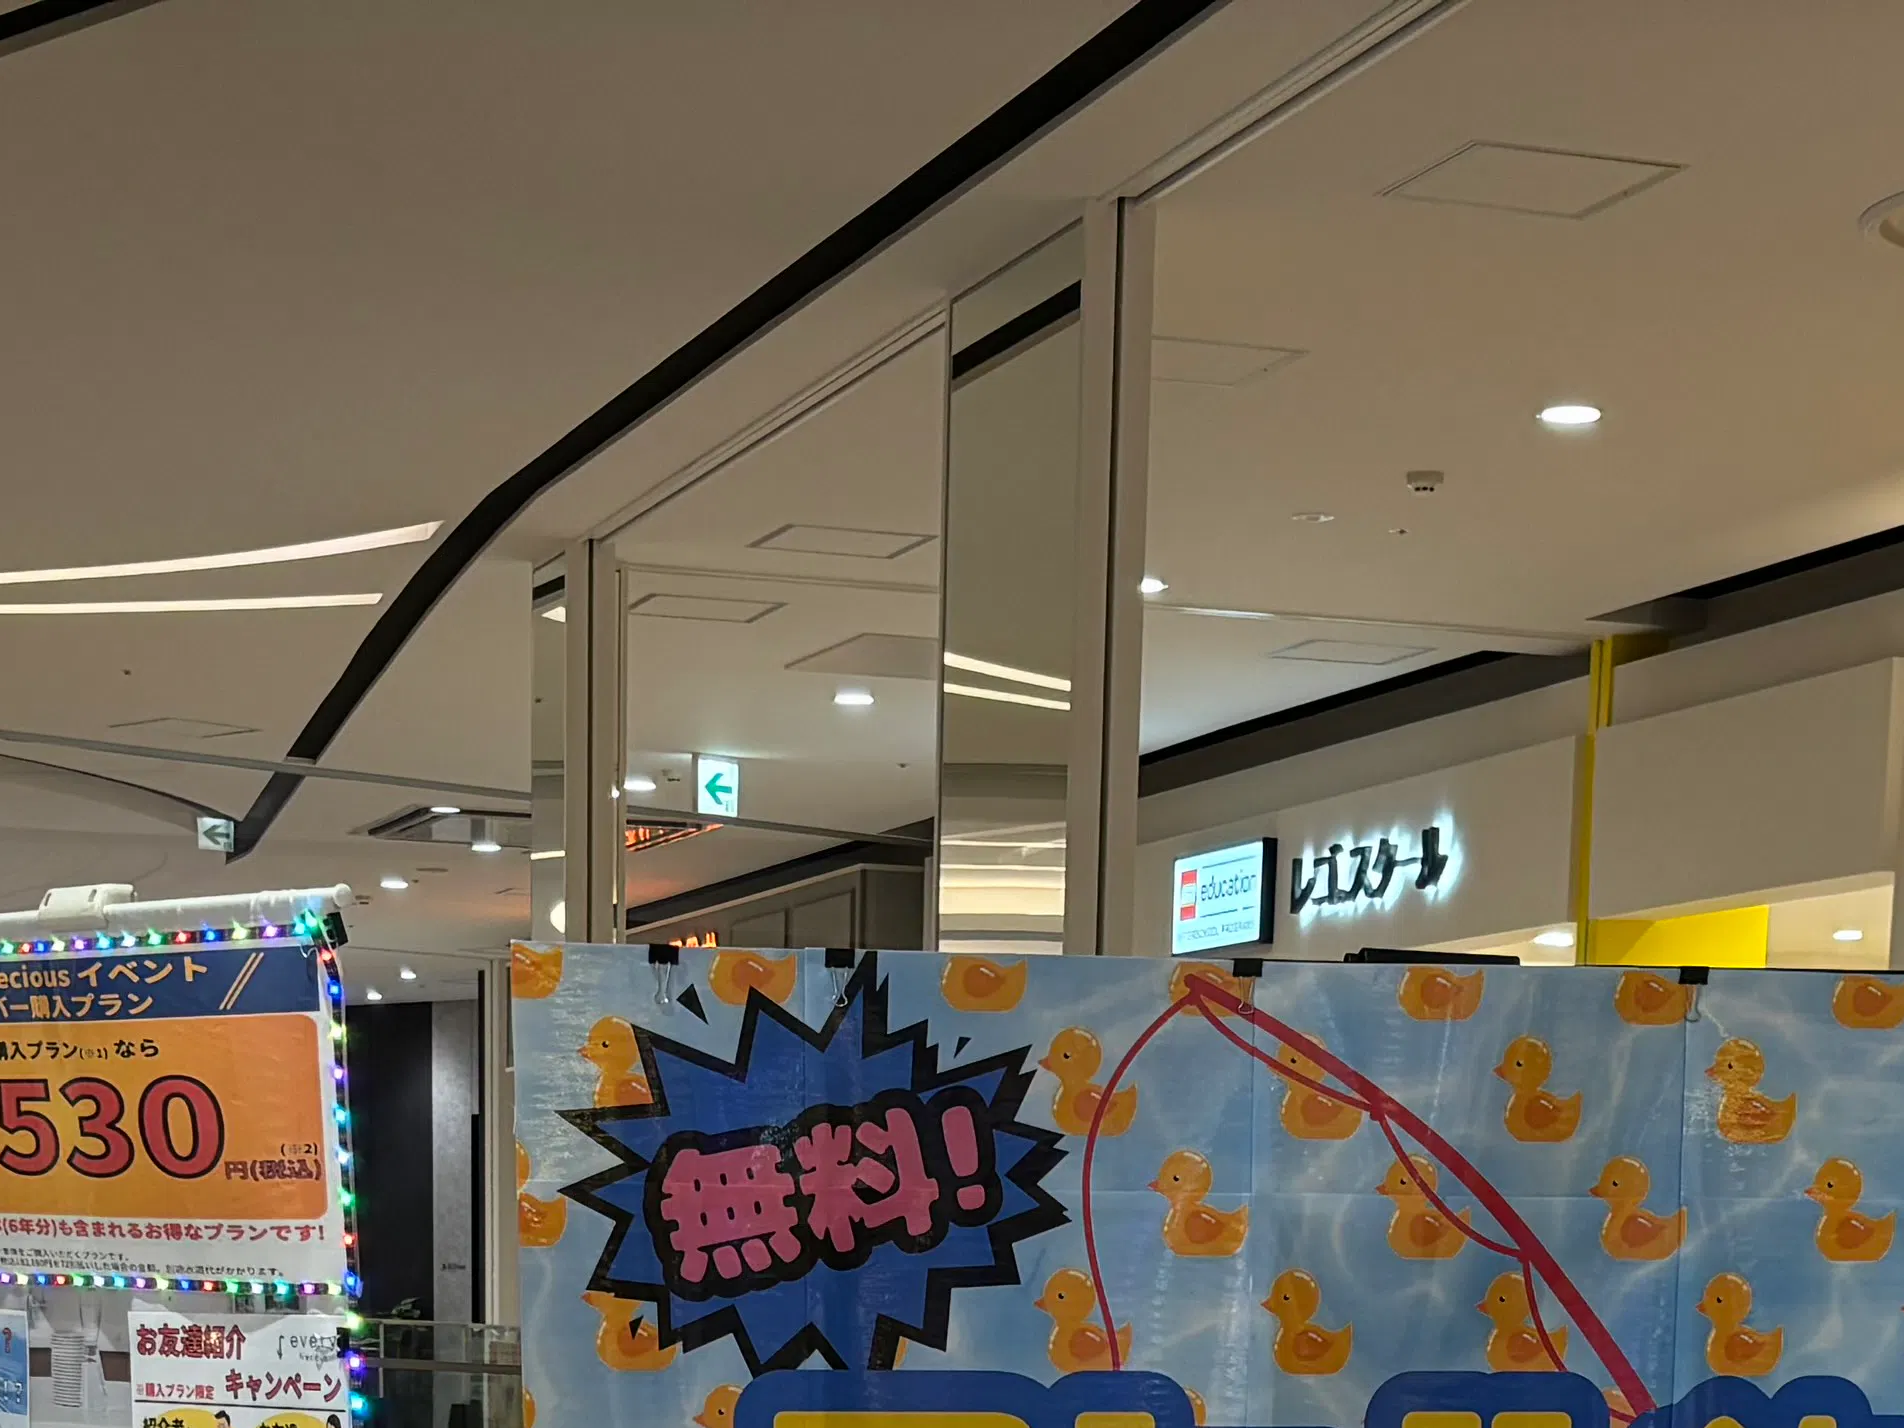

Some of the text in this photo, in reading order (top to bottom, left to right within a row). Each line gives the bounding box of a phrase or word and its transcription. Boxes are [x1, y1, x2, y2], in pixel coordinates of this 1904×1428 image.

[1201, 869, 1256, 901] education
[1290, 827, 1448, 914] レゴスクール
[77, 954, 207, 987] イベント
[136, 1323, 246, 1360] お友達紹介
[225, 1368, 341, 1402] キャンペーン
